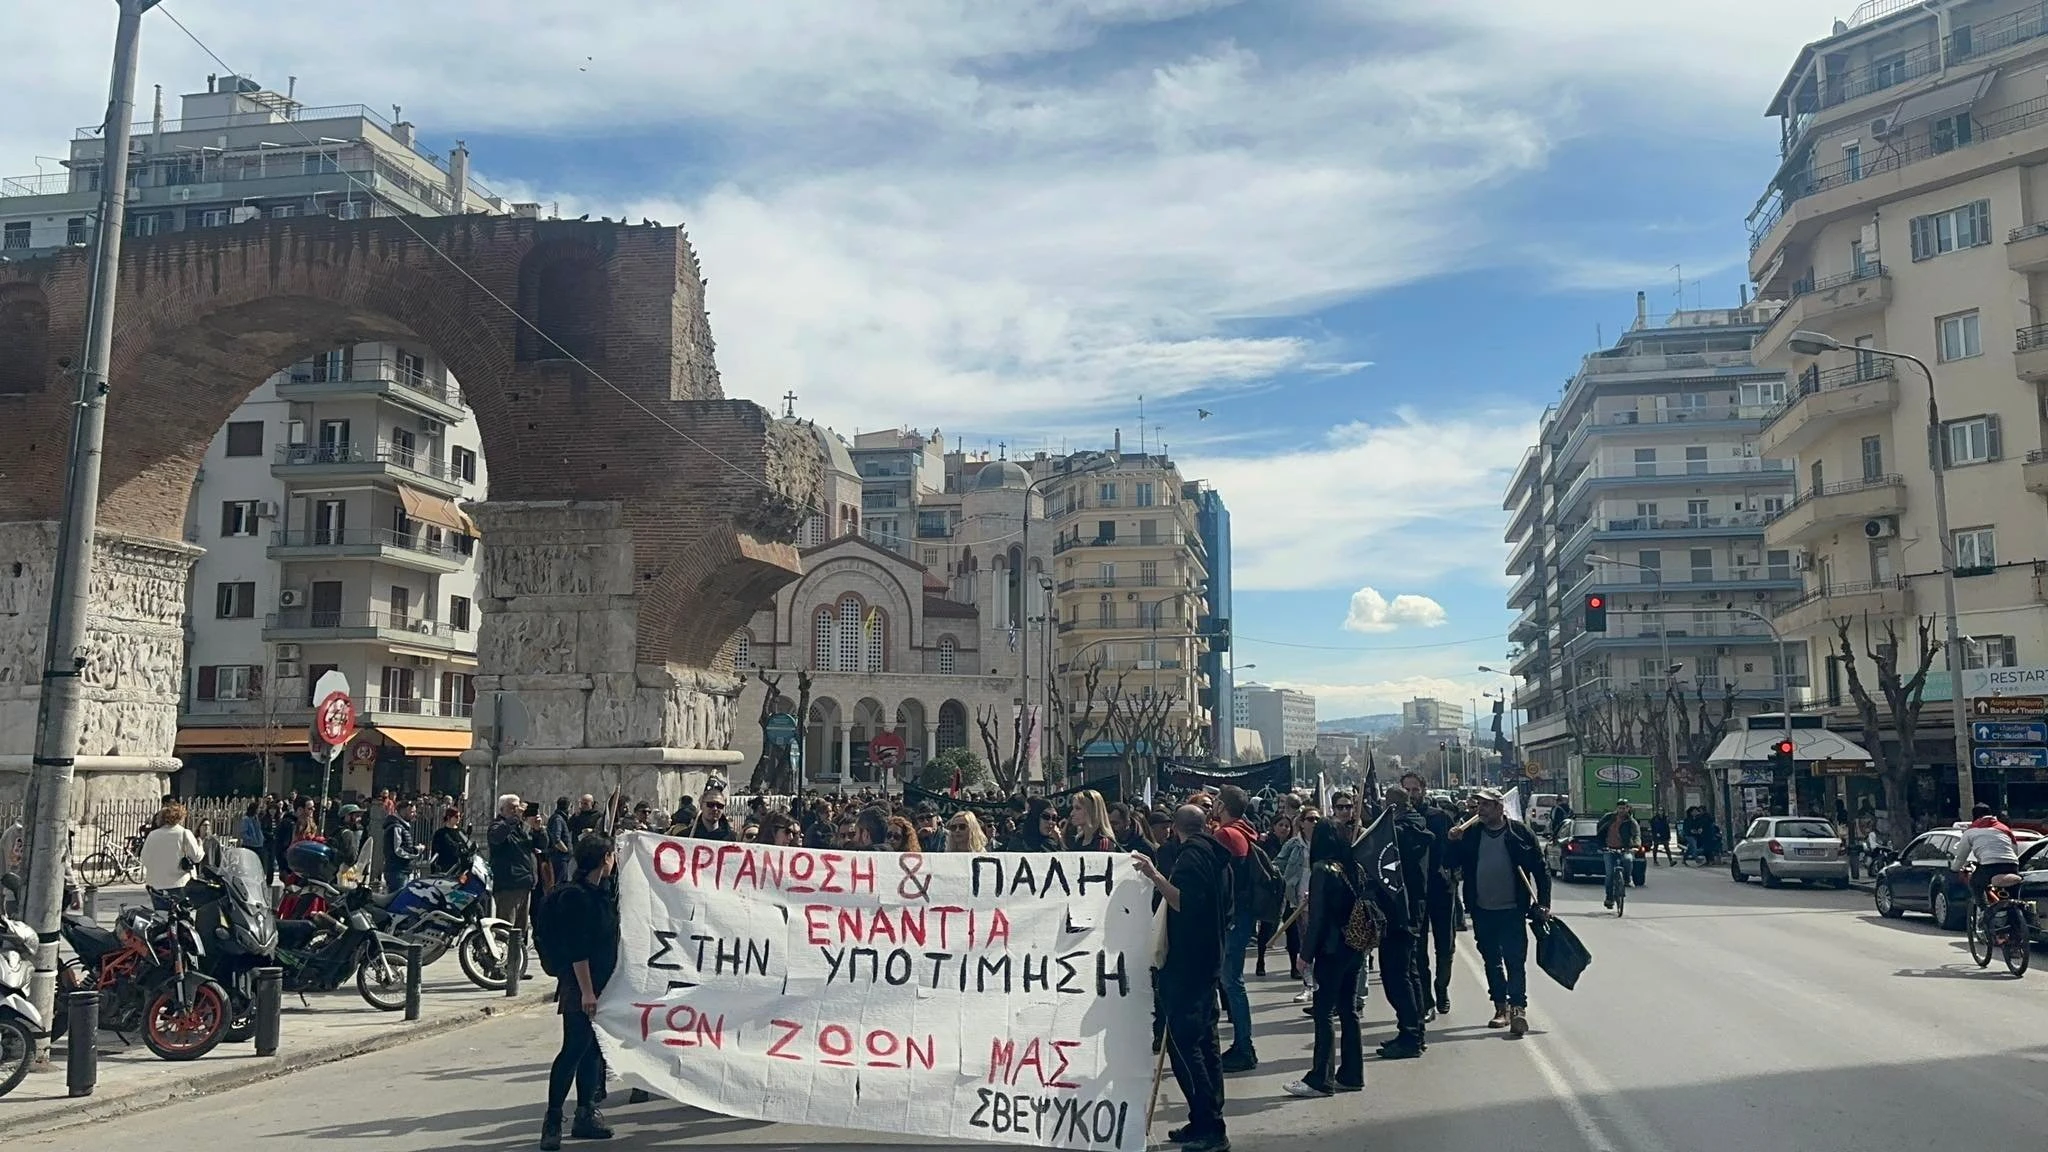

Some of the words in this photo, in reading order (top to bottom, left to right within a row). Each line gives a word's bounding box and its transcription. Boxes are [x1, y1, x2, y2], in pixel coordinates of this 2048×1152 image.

[653, 841, 876, 895] ΟΡΓΑΝΩΣΗ
[897, 852, 931, 902] &
[971, 856, 1114, 897] ΠΑΛΗ
[807, 904, 1011, 951] ΕΝΑΝΤΙΑ
[647, 931, 770, 976] ΣΤΗΝ
[823, 946, 1130, 997] ΥΠΟΤΙΜΗΣΗ
[631, 1001, 725, 1050] ΤΩΝ
[988, 1036, 1083, 1090] ΜΑΣ
[969, 1088, 1129, 1150] ΣΒΕΨΥΚΟΙ
